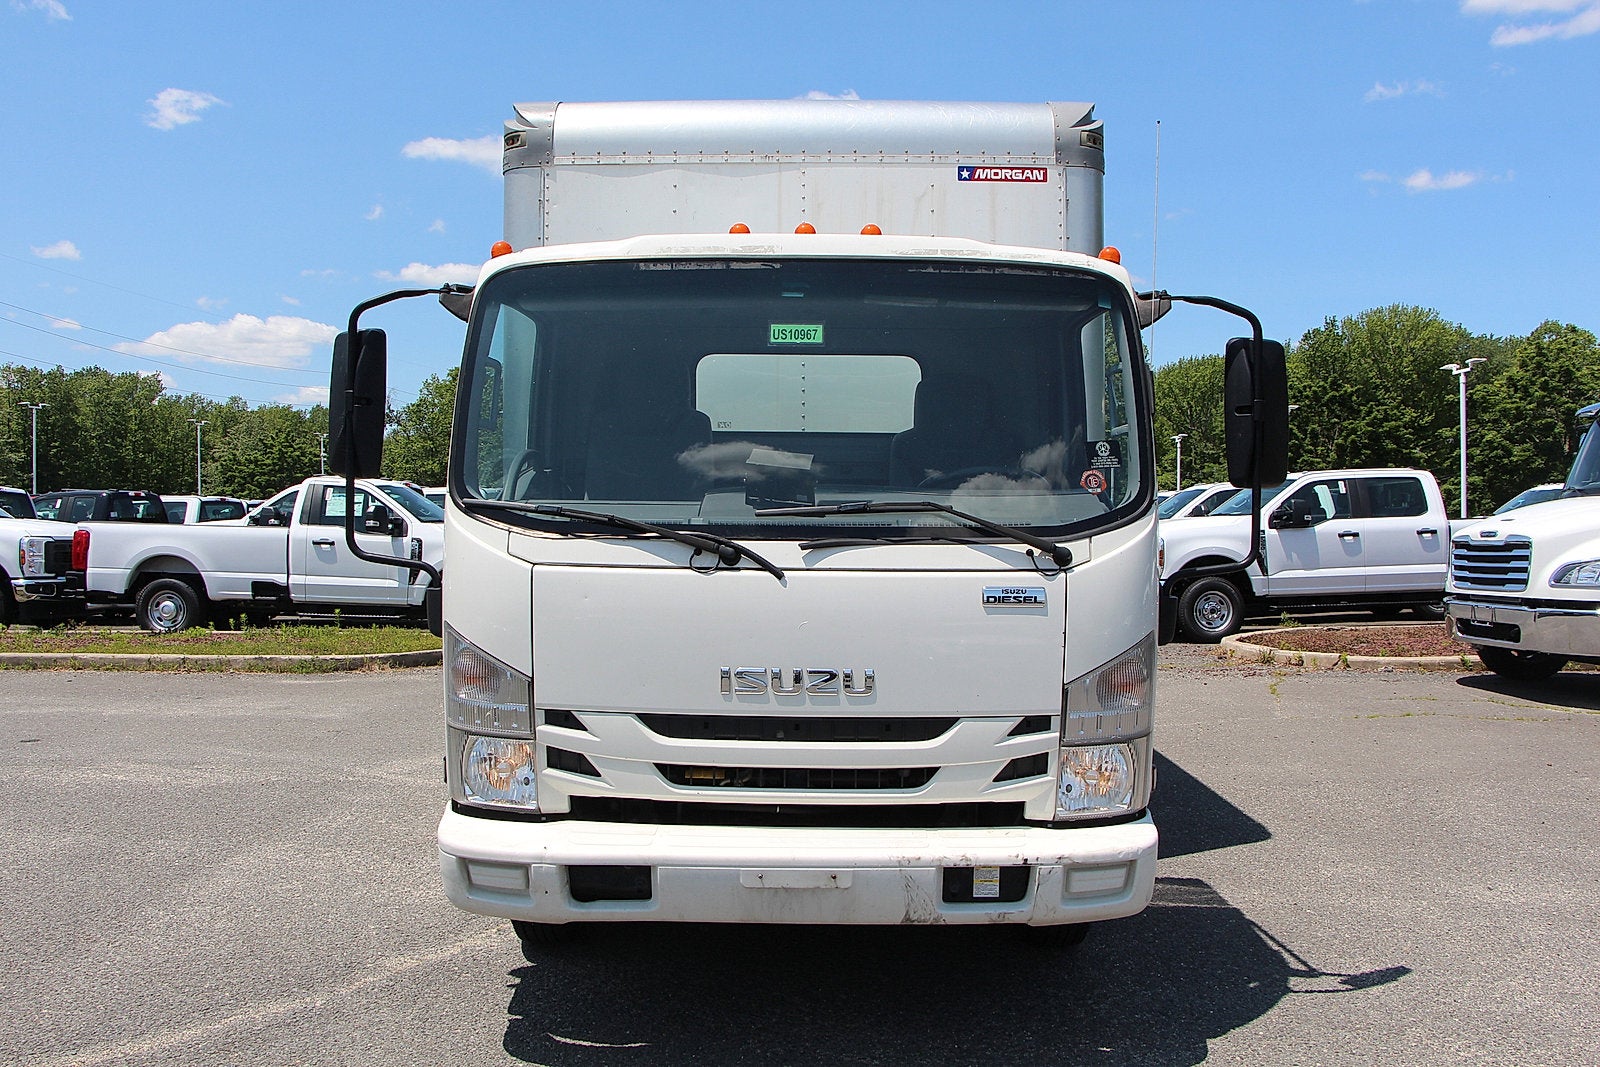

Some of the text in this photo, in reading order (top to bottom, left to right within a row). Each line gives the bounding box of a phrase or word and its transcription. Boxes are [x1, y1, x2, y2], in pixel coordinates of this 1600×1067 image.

[974, 168, 1044, 180] MORGAN
[772, 328, 818, 340] US10967
[985, 595, 1043, 604] DIESEL
[720, 666, 875, 697] ISUZU
